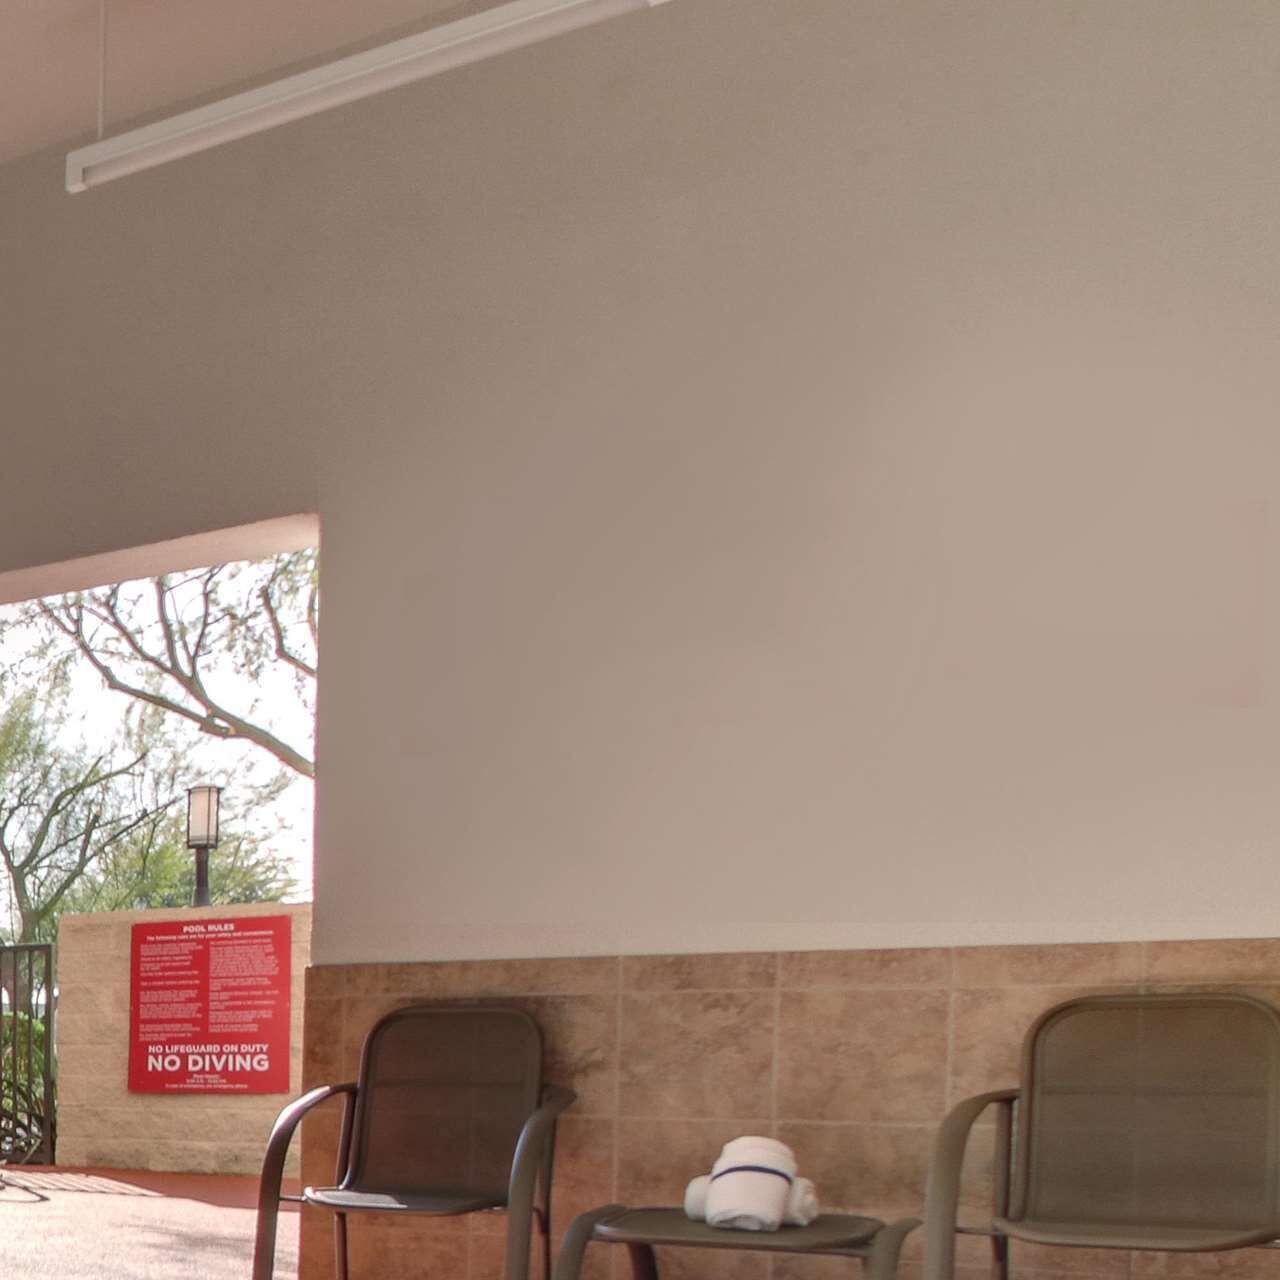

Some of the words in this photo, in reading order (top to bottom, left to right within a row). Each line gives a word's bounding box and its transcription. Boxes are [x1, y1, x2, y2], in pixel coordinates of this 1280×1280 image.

[183, 924, 206, 933] POOL
[208, 923, 235, 932] RULES
[148, 1044, 163, 1054] NO
[165, 1044, 220, 1053] LIFEGUARD
[222, 1044, 239, 1053] ON
[240, 1044, 269, 1053] DUTY
[147, 1054, 181, 1072] NO
[188, 1054, 269, 1072] DIVING
